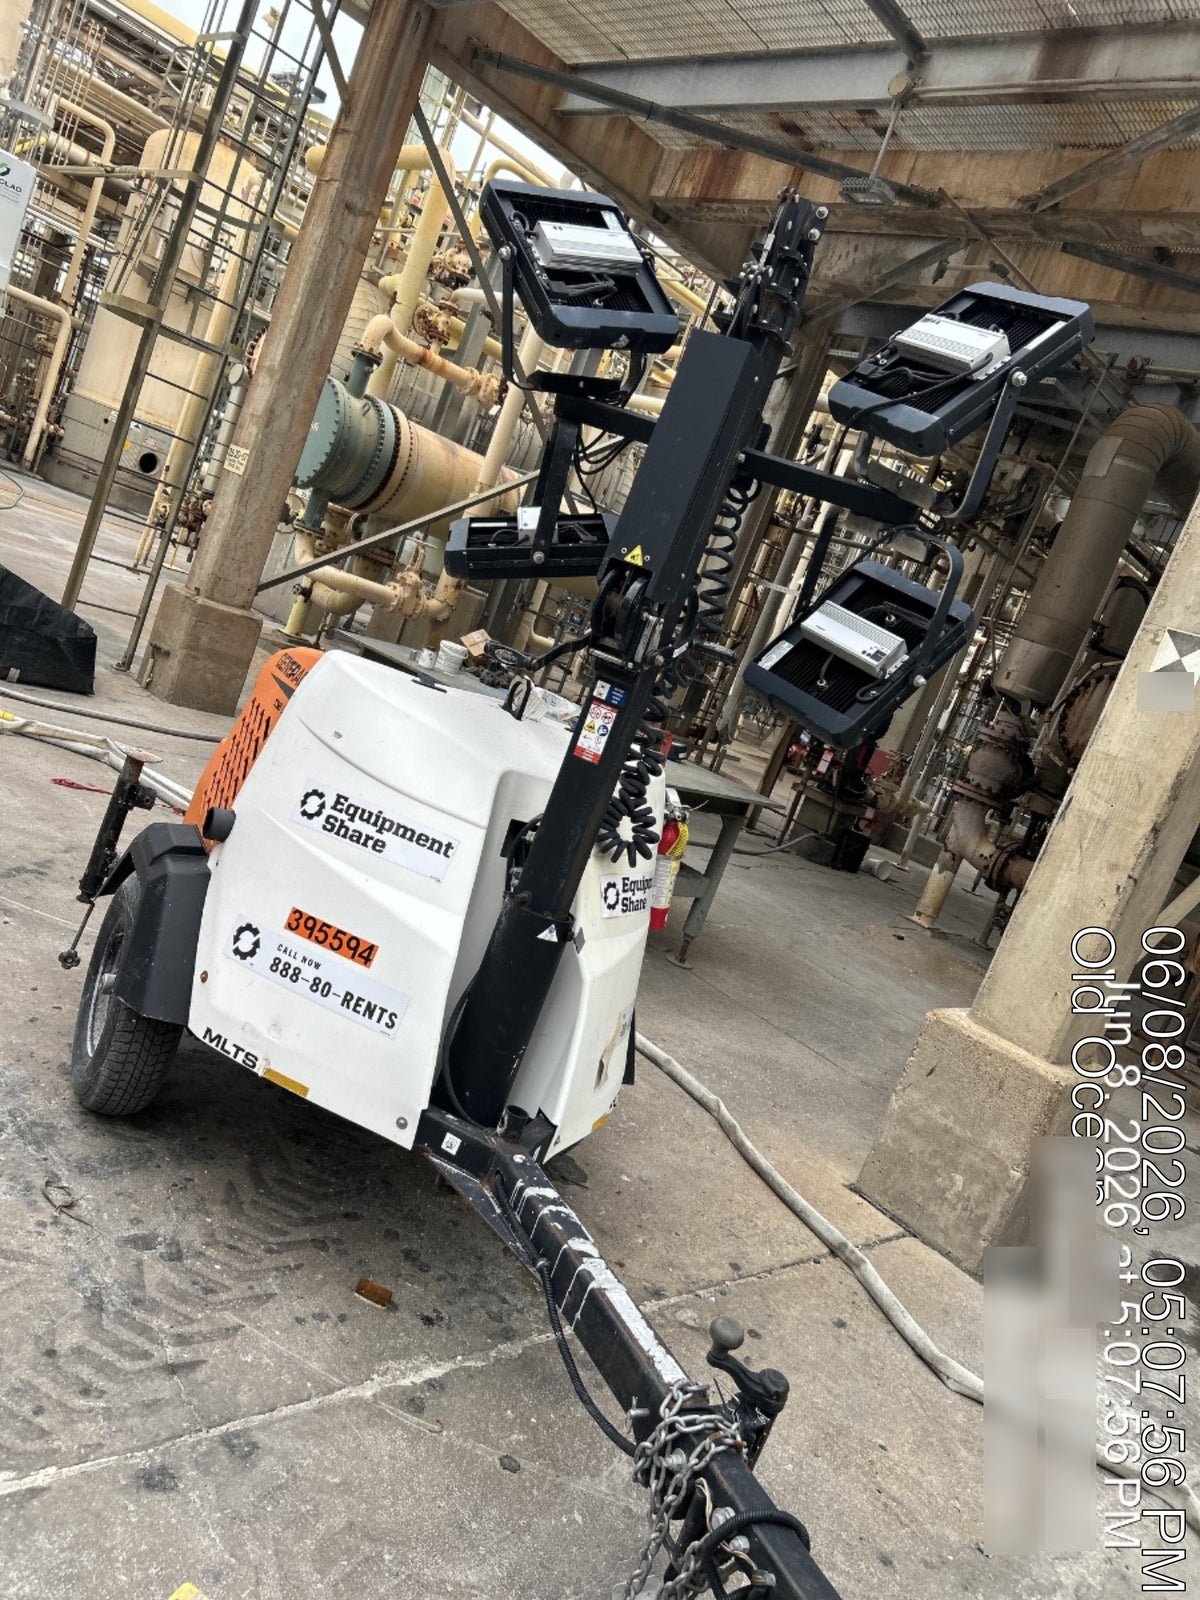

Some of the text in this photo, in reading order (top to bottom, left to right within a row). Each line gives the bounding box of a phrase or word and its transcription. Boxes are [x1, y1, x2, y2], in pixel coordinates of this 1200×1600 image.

[322, 813, 387, 854] Share
[330, 793, 454, 859] Equipment
[276, 943, 322, 970] CALL NOW
[287, 908, 375, 966] 395594
[269, 956, 398, 1030] 888-80-RENTS
[202, 1027, 258, 1070] MLTS
